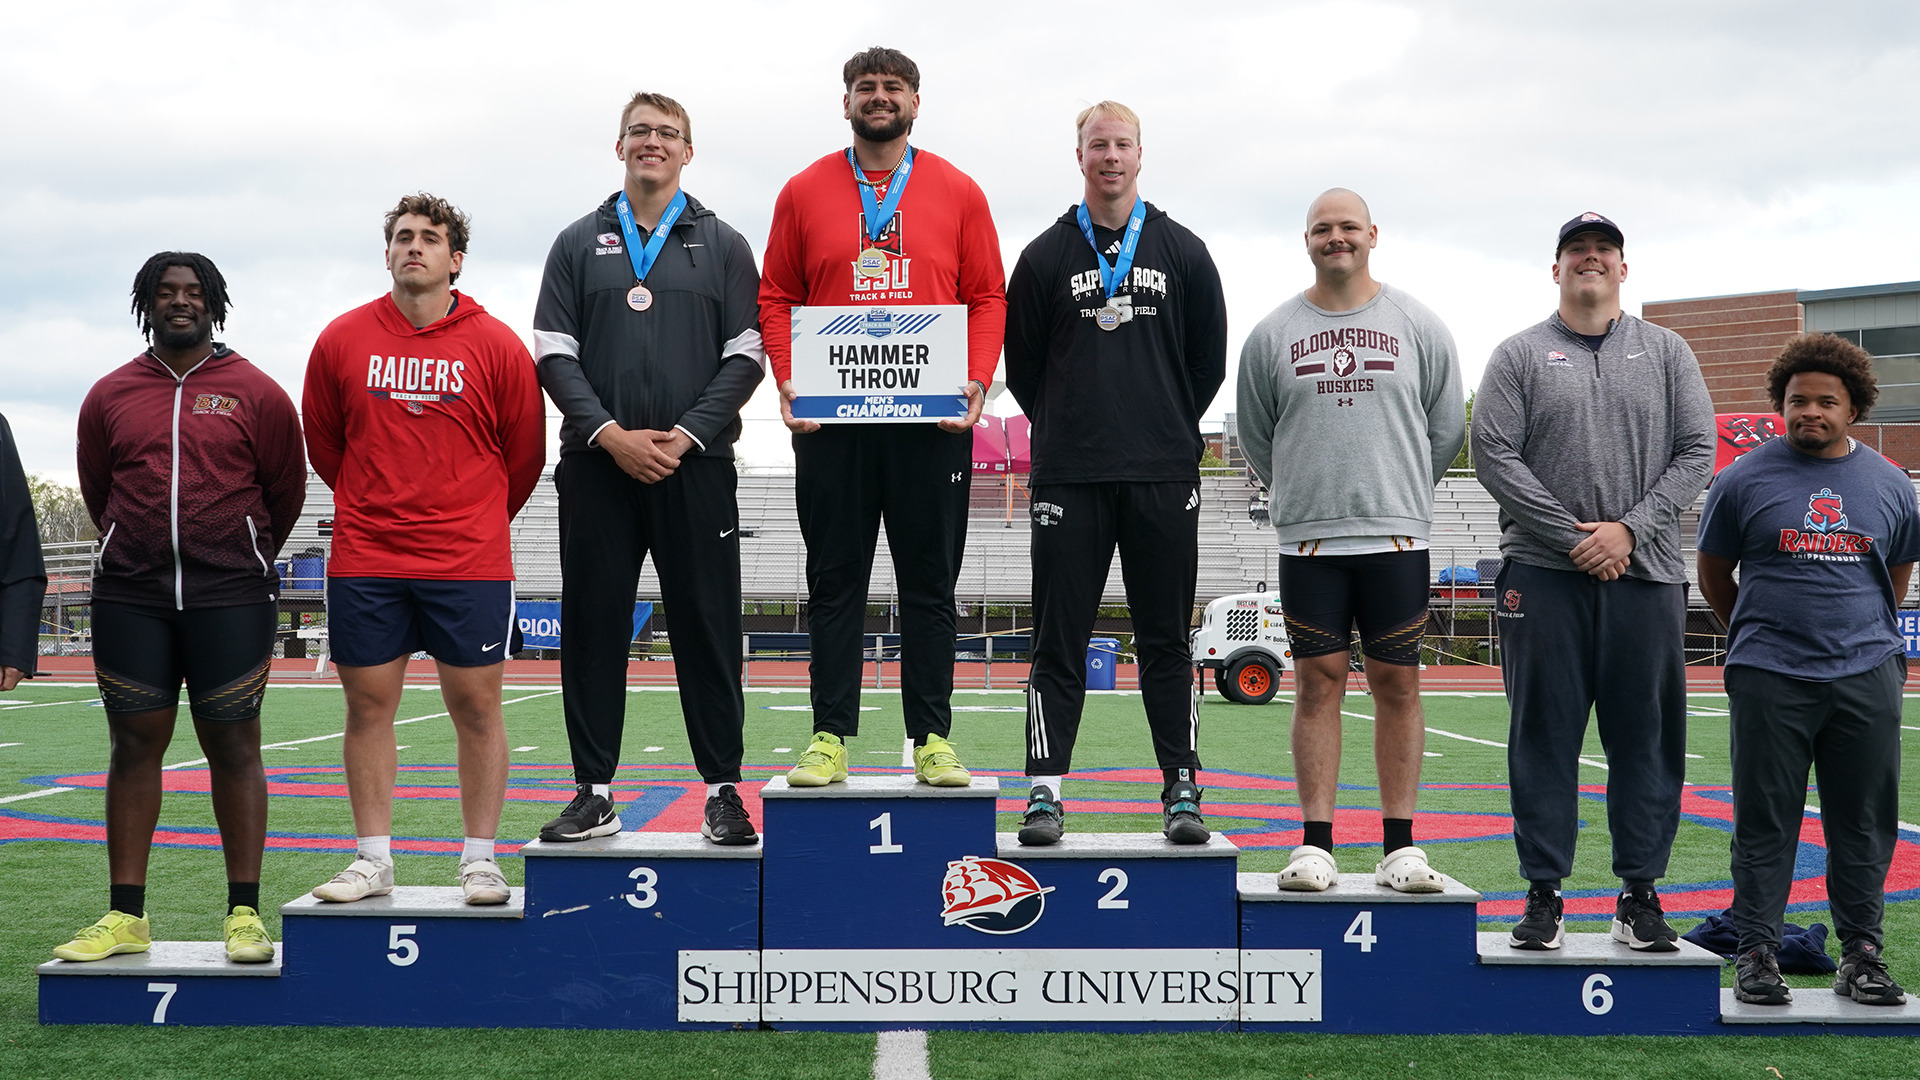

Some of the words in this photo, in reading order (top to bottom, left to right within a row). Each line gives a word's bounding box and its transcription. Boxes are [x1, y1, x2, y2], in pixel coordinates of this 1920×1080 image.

[849, 293, 878, 301] TRACK
[889, 291, 913, 299] FIELD
[1071, 266, 1129, 296] SLIPY
[1133, 266, 1167, 294] ROCK
[1075, 287, 1166, 301] UNIRSITY
[1080, 308, 1101, 318] TRA
[1134, 307, 1157, 315] FIELD
[829, 344, 930, 366] HAMMER
[1290, 328, 1399, 364] BLOOMSBURG
[366, 354, 465, 394] RAIDERS
[837, 368, 920, 389] THROW
[1317, 379, 1374, 394] HUSKIES
[836, 404, 923, 417] CHAMPION
[864, 396, 894, 405] MEN'S
[1778, 528, 1874, 554] RAIDERS
[1791, 552, 1861, 562] SHIPPENSBURG
[869, 812, 903, 854] 1
[625, 867, 658, 909] 3
[1097, 867, 1129, 909] 2
[386, 925, 419, 967] 5
[1343, 911, 1376, 953] 4
[683, 965, 1018, 1004] SHIPPENSBURG
[1042, 970, 1315, 1004] UNIVERSITY
[1583, 973, 1614, 1015] 6
[147, 982, 177, 1023] 7
